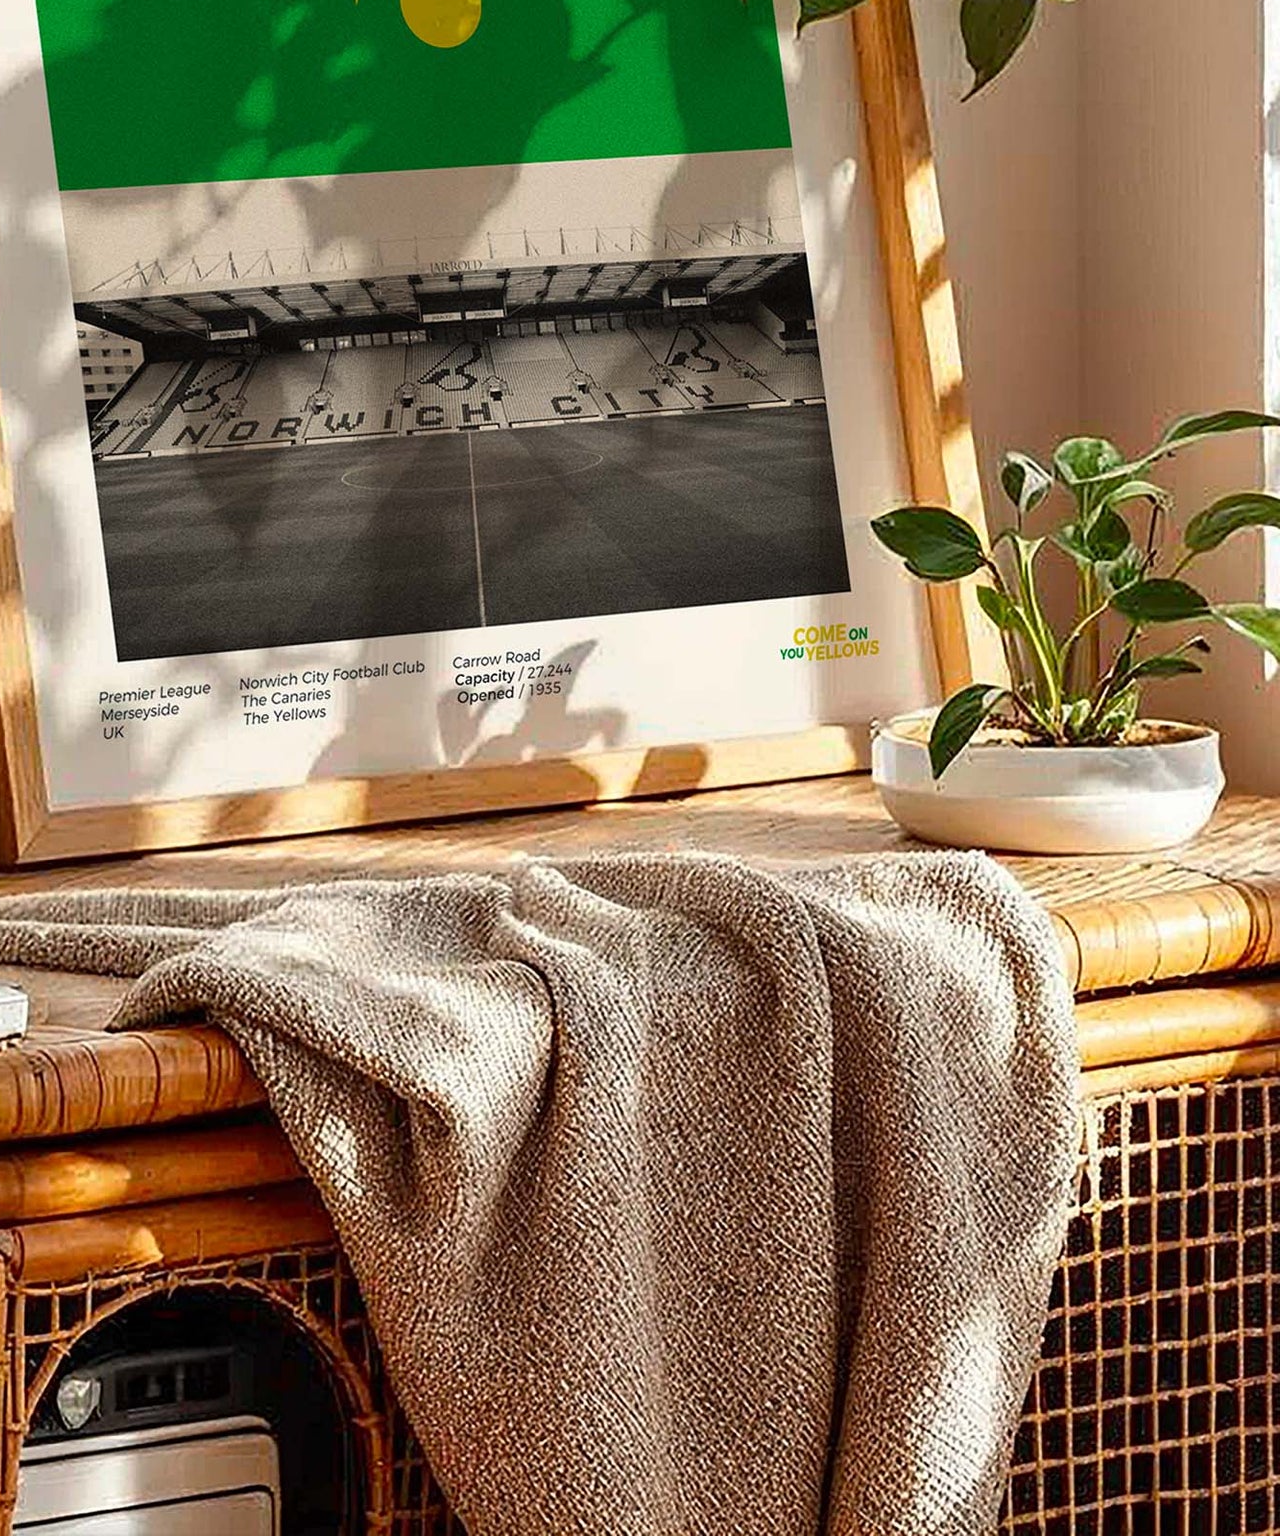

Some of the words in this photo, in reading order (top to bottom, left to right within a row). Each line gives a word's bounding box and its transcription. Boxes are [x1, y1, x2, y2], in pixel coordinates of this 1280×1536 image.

[430, 259, 483, 275] JARROLD
[172, 402, 492, 446] NORWICH
[551, 385, 715, 415] CITY
[793, 623, 847, 646] COME
[849, 627, 868, 640] ON
[452, 655, 502, 669] Carrow
[505, 648, 541, 664] Road
[780, 647, 804, 660] YOU
[806, 640, 879, 661] YELLOWS
[239, 672, 298, 691] Norwich
[301, 670, 329, 685] City
[333, 663, 389, 681] Football
[392, 660, 425, 675] Club
[454, 669, 515, 687] Capacity
[99, 687, 156, 705] Premier
[160, 683, 211, 699] League
[241, 694, 267, 708] The
[271, 688, 331, 705] Canaries
[457, 685, 515, 707] Opened
[529, 681, 561, 697] 1935
[101, 702, 180, 722] Merseyside
[243, 711, 270, 725] The
[273, 707, 326, 722] Yellows
[103, 725, 124, 740] UK
